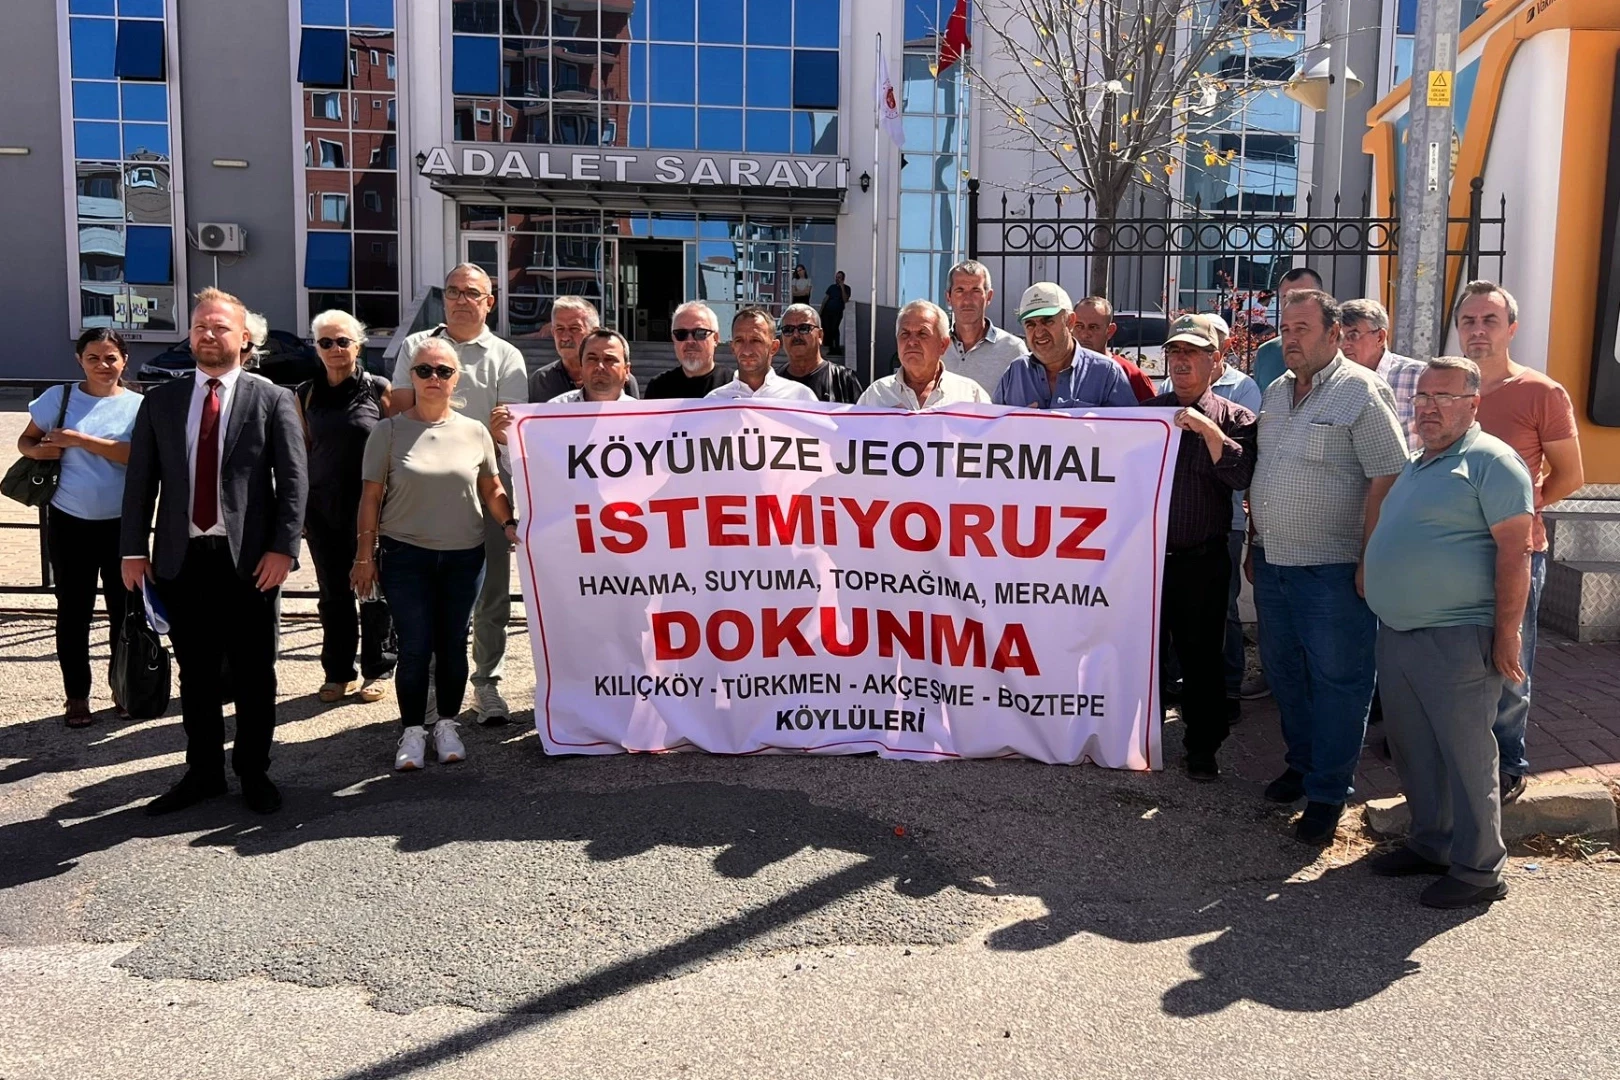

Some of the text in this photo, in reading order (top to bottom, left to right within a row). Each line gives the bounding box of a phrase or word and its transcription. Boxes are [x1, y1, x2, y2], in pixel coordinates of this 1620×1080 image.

[420, 146, 848, 190] ADALET SARAYI
[567, 428, 1116, 483] KÖYÜMÜZE JEOTERMAL
[579, 568, 1109, 608] HAVAMA, SUYUMA, TOPRAĞIMA, MERAMA
[651, 606, 1040, 676] DOKUNMA
[594, 673, 704, 701] KILIÇKÖY
[721, 671, 841, 699] TÜRKMEN
[862, 674, 974, 708] AKÇEŞME
[997, 686, 1105, 717] BOZTEPE
[775, 704, 926, 734] KÖYLÜLERİ
